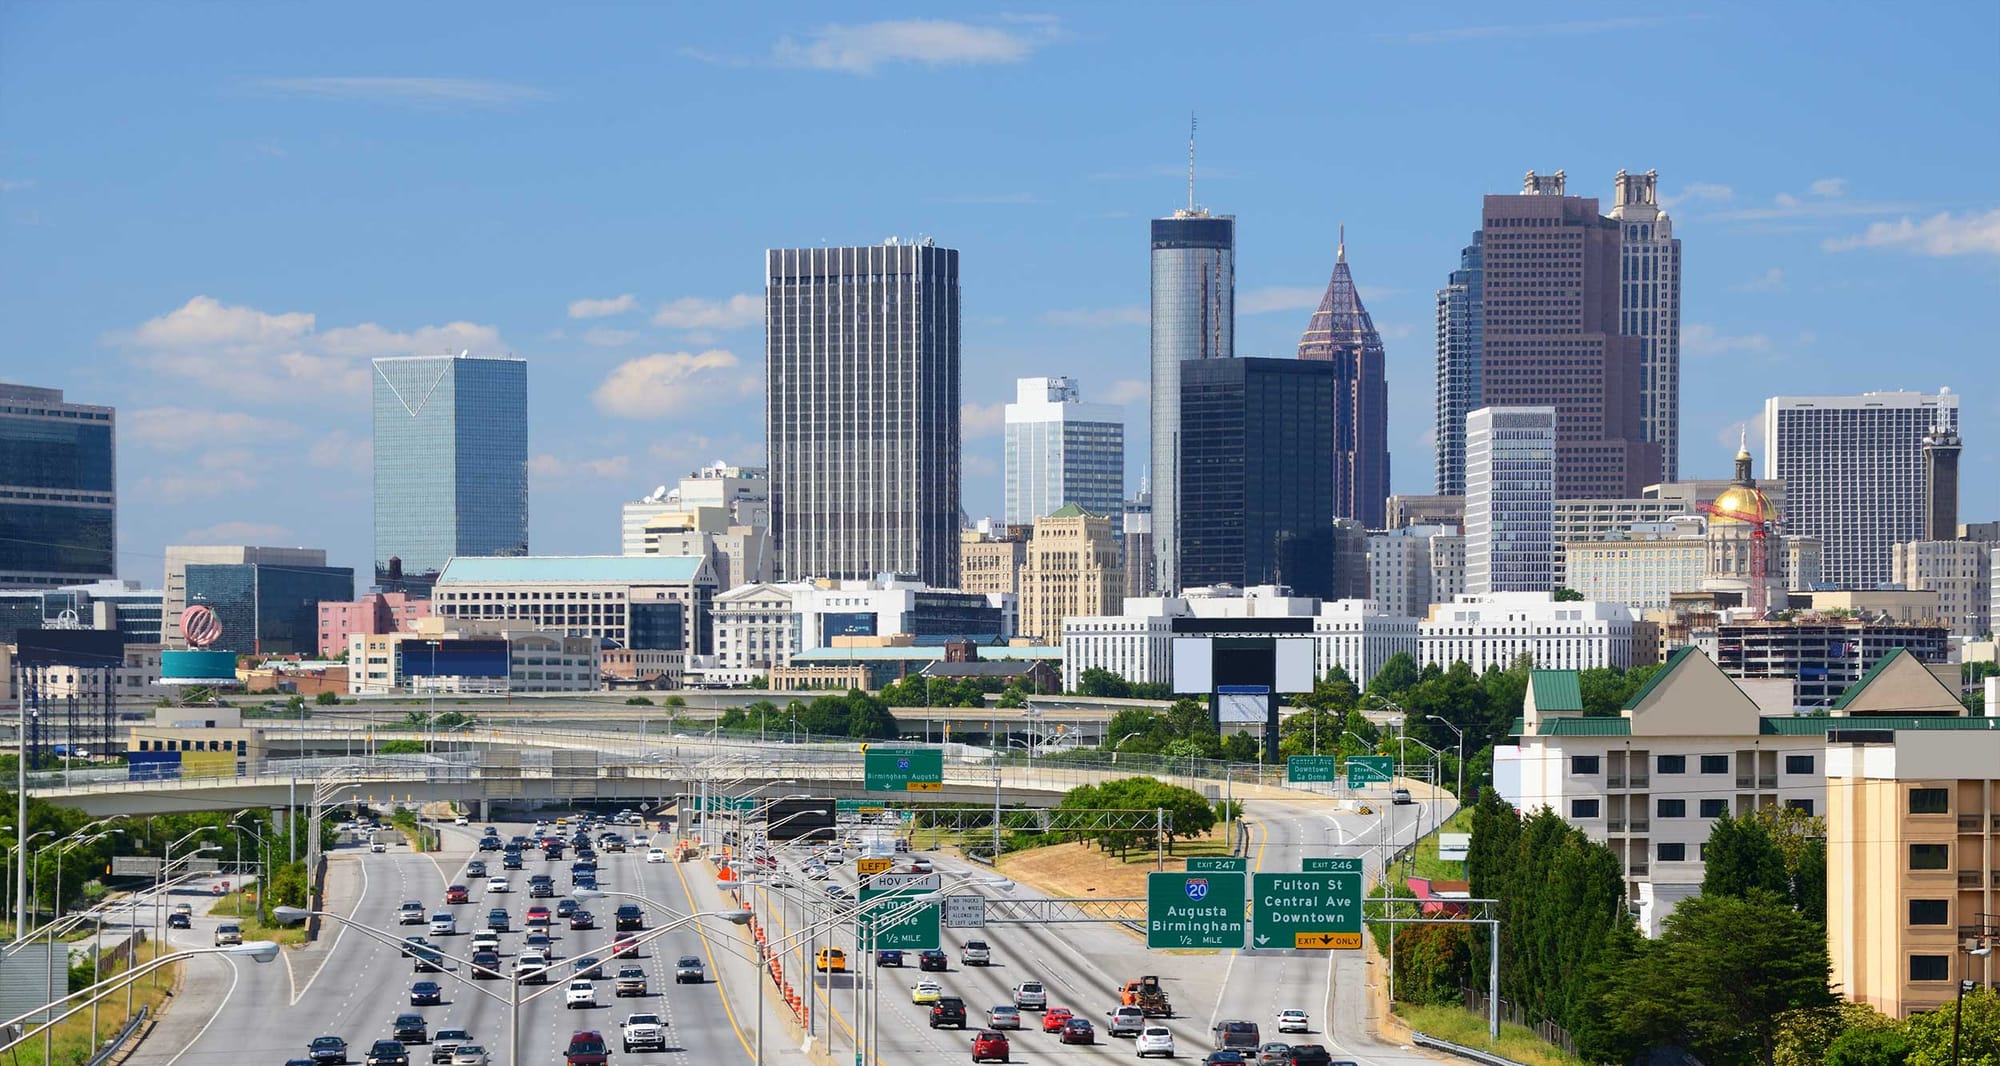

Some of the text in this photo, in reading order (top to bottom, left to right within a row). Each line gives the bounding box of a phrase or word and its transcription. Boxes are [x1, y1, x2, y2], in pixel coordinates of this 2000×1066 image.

[862, 862, 887, 871] LEFT
[1331, 861, 1352, 869] 246
[879, 878, 901, 886] HOV
[1274, 880, 1342, 890] Fulton St
[1189, 884, 1206, 896] 20
[1265, 896, 1351, 906] Central Ave
[1168, 906, 1227, 919] Augusta
[1273, 912, 1344, 922] Downtown
[1152, 920, 1241, 934] Birmingham
